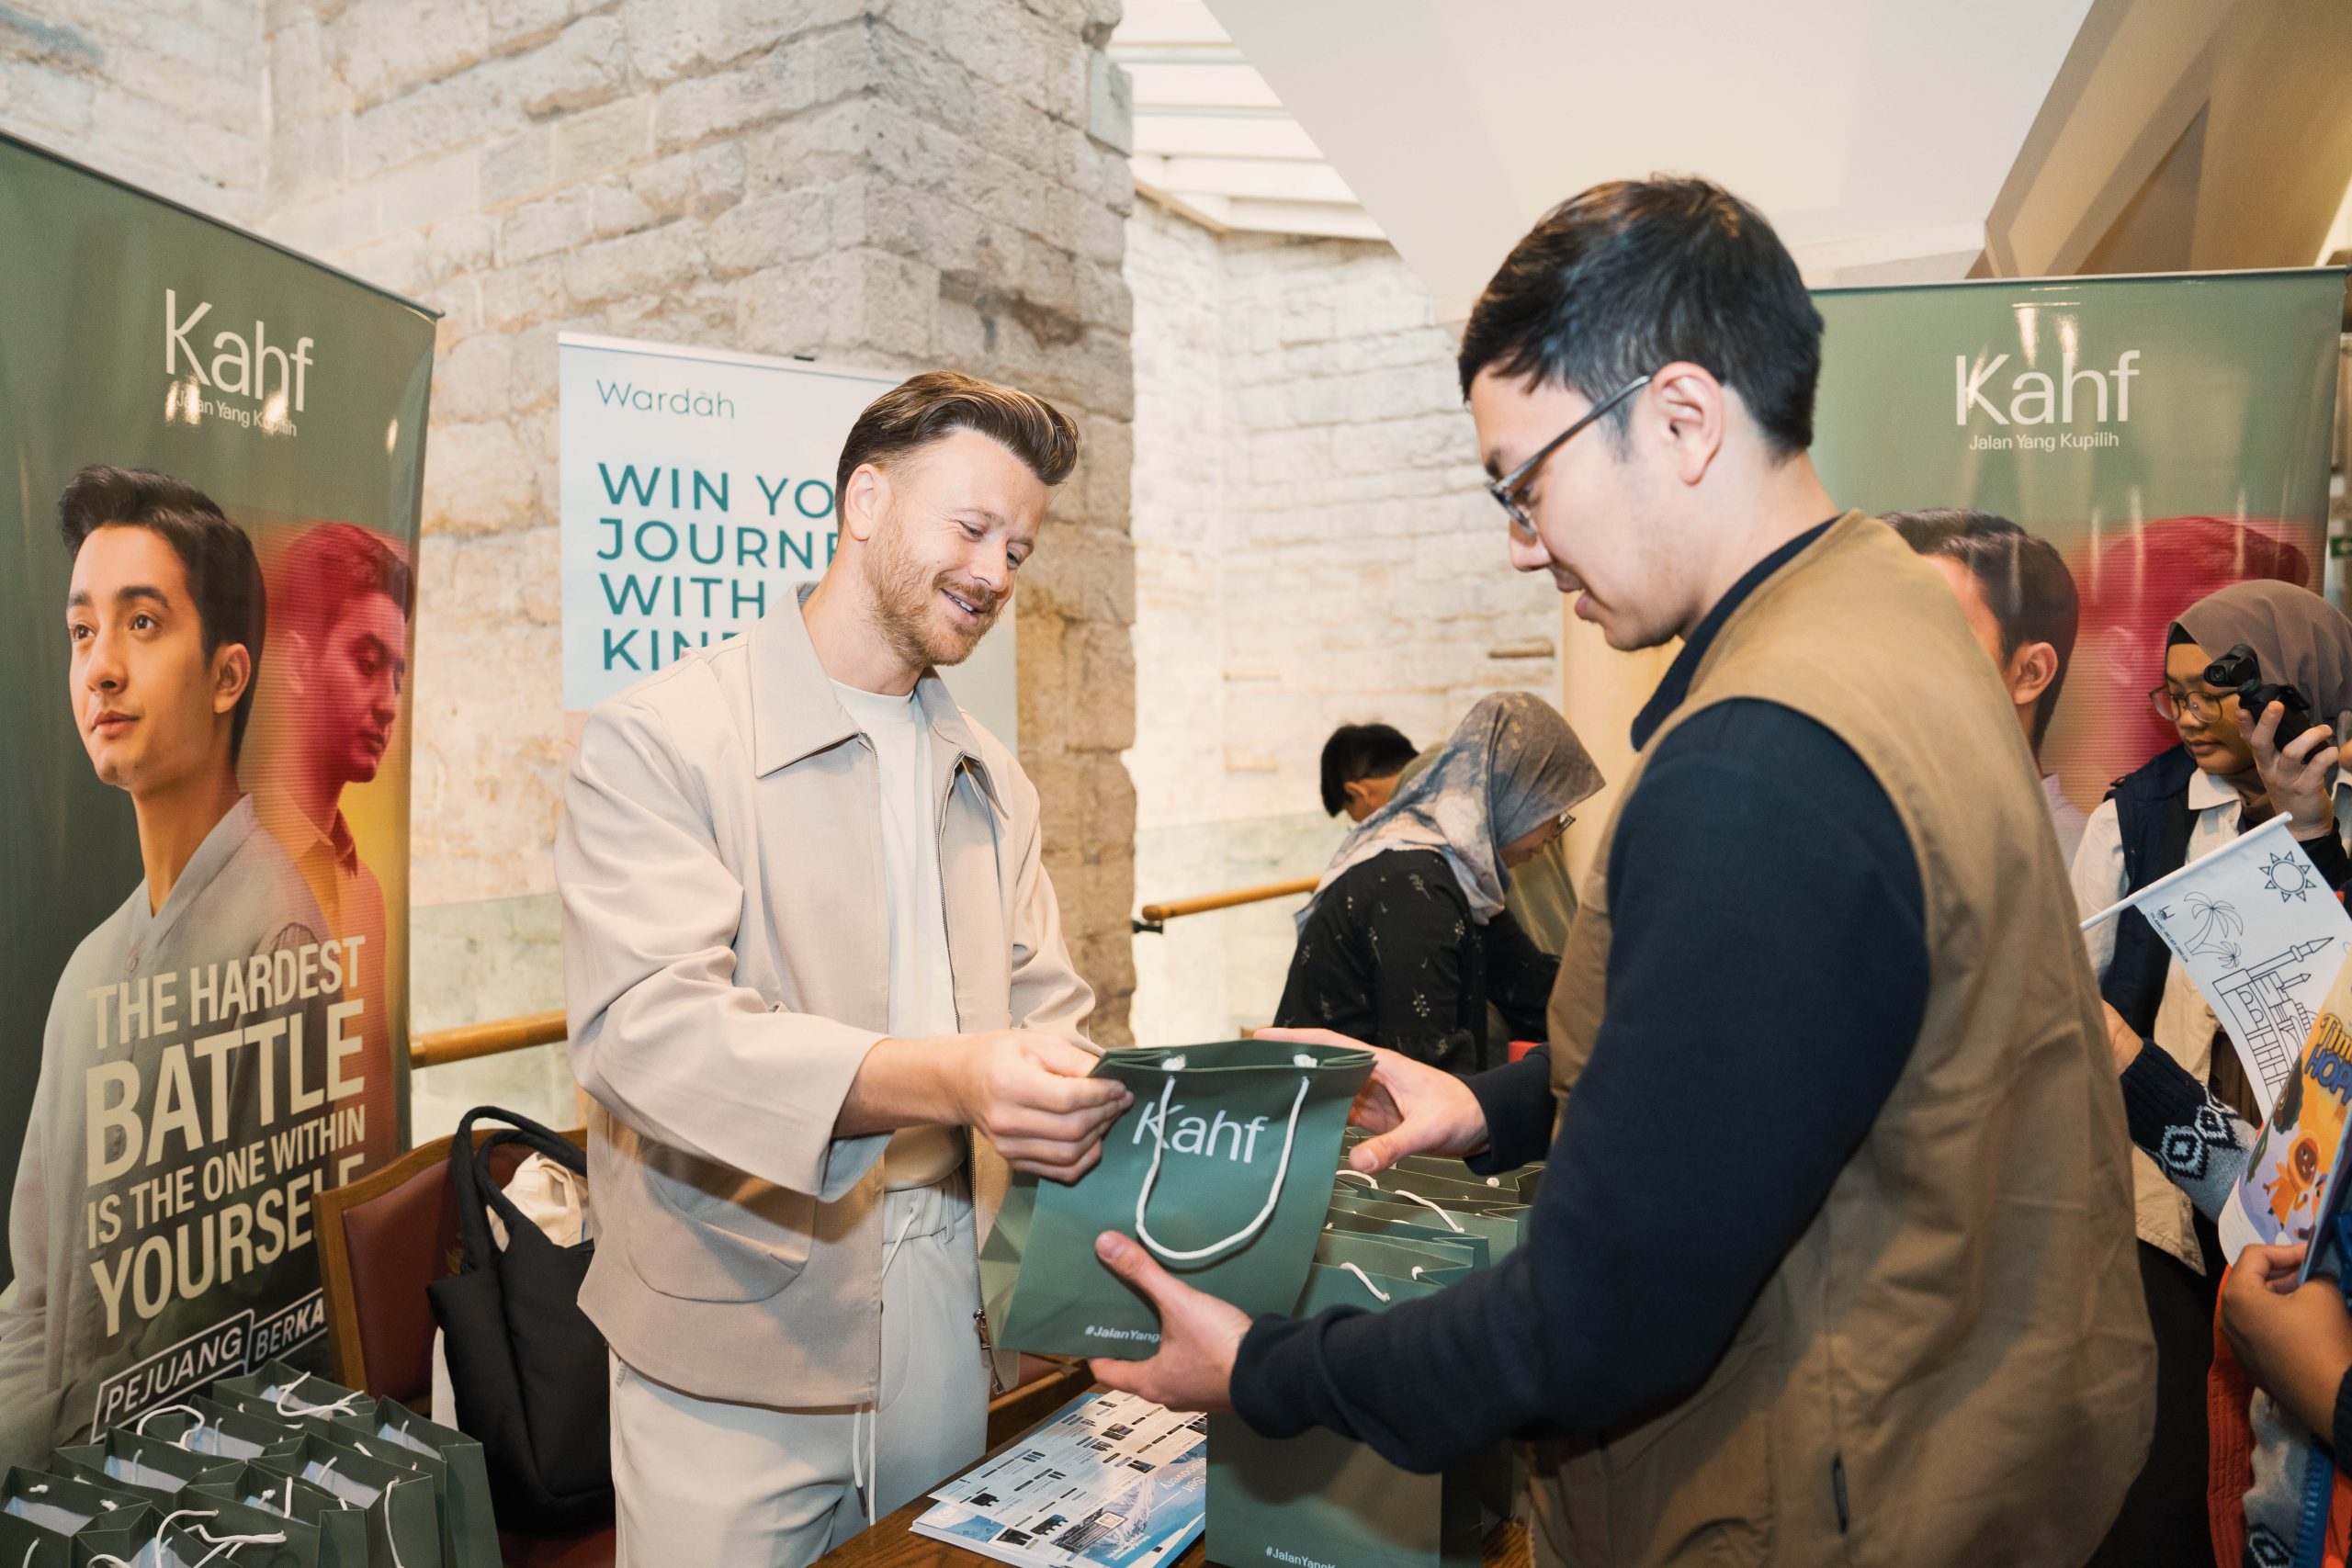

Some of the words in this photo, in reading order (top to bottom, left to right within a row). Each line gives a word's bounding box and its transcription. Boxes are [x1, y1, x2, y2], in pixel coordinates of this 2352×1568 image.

[165, 288, 314, 412] Kahf
[176, 389, 214, 416] Jan
[216, 399, 251, 429] Yang
[1956, 349, 2141, 426] Kahf
[1969, 434, 2013, 450] Jalan
[2016, 434, 2055, 452] Yang
[2060, 432, 2120, 451] Kupilih
[597, 462, 729, 512] WIN
[599, 572, 764, 619] WITH
[603, 628, 741, 671] KIN
[86, 972, 178, 1051] THE
[190, 934, 366, 1027] HARDEST
[86, 998, 366, 1187] BATTLE
[1132, 1101, 1270, 1164] Kahf
[87, 1194, 121, 1249] IS
[130, 1165, 196, 1231] THE
[202, 1141, 266, 1202] ONE
[270, 1104, 366, 1176] WITHIN
[106, 1326, 243, 1423] PEJUANG
